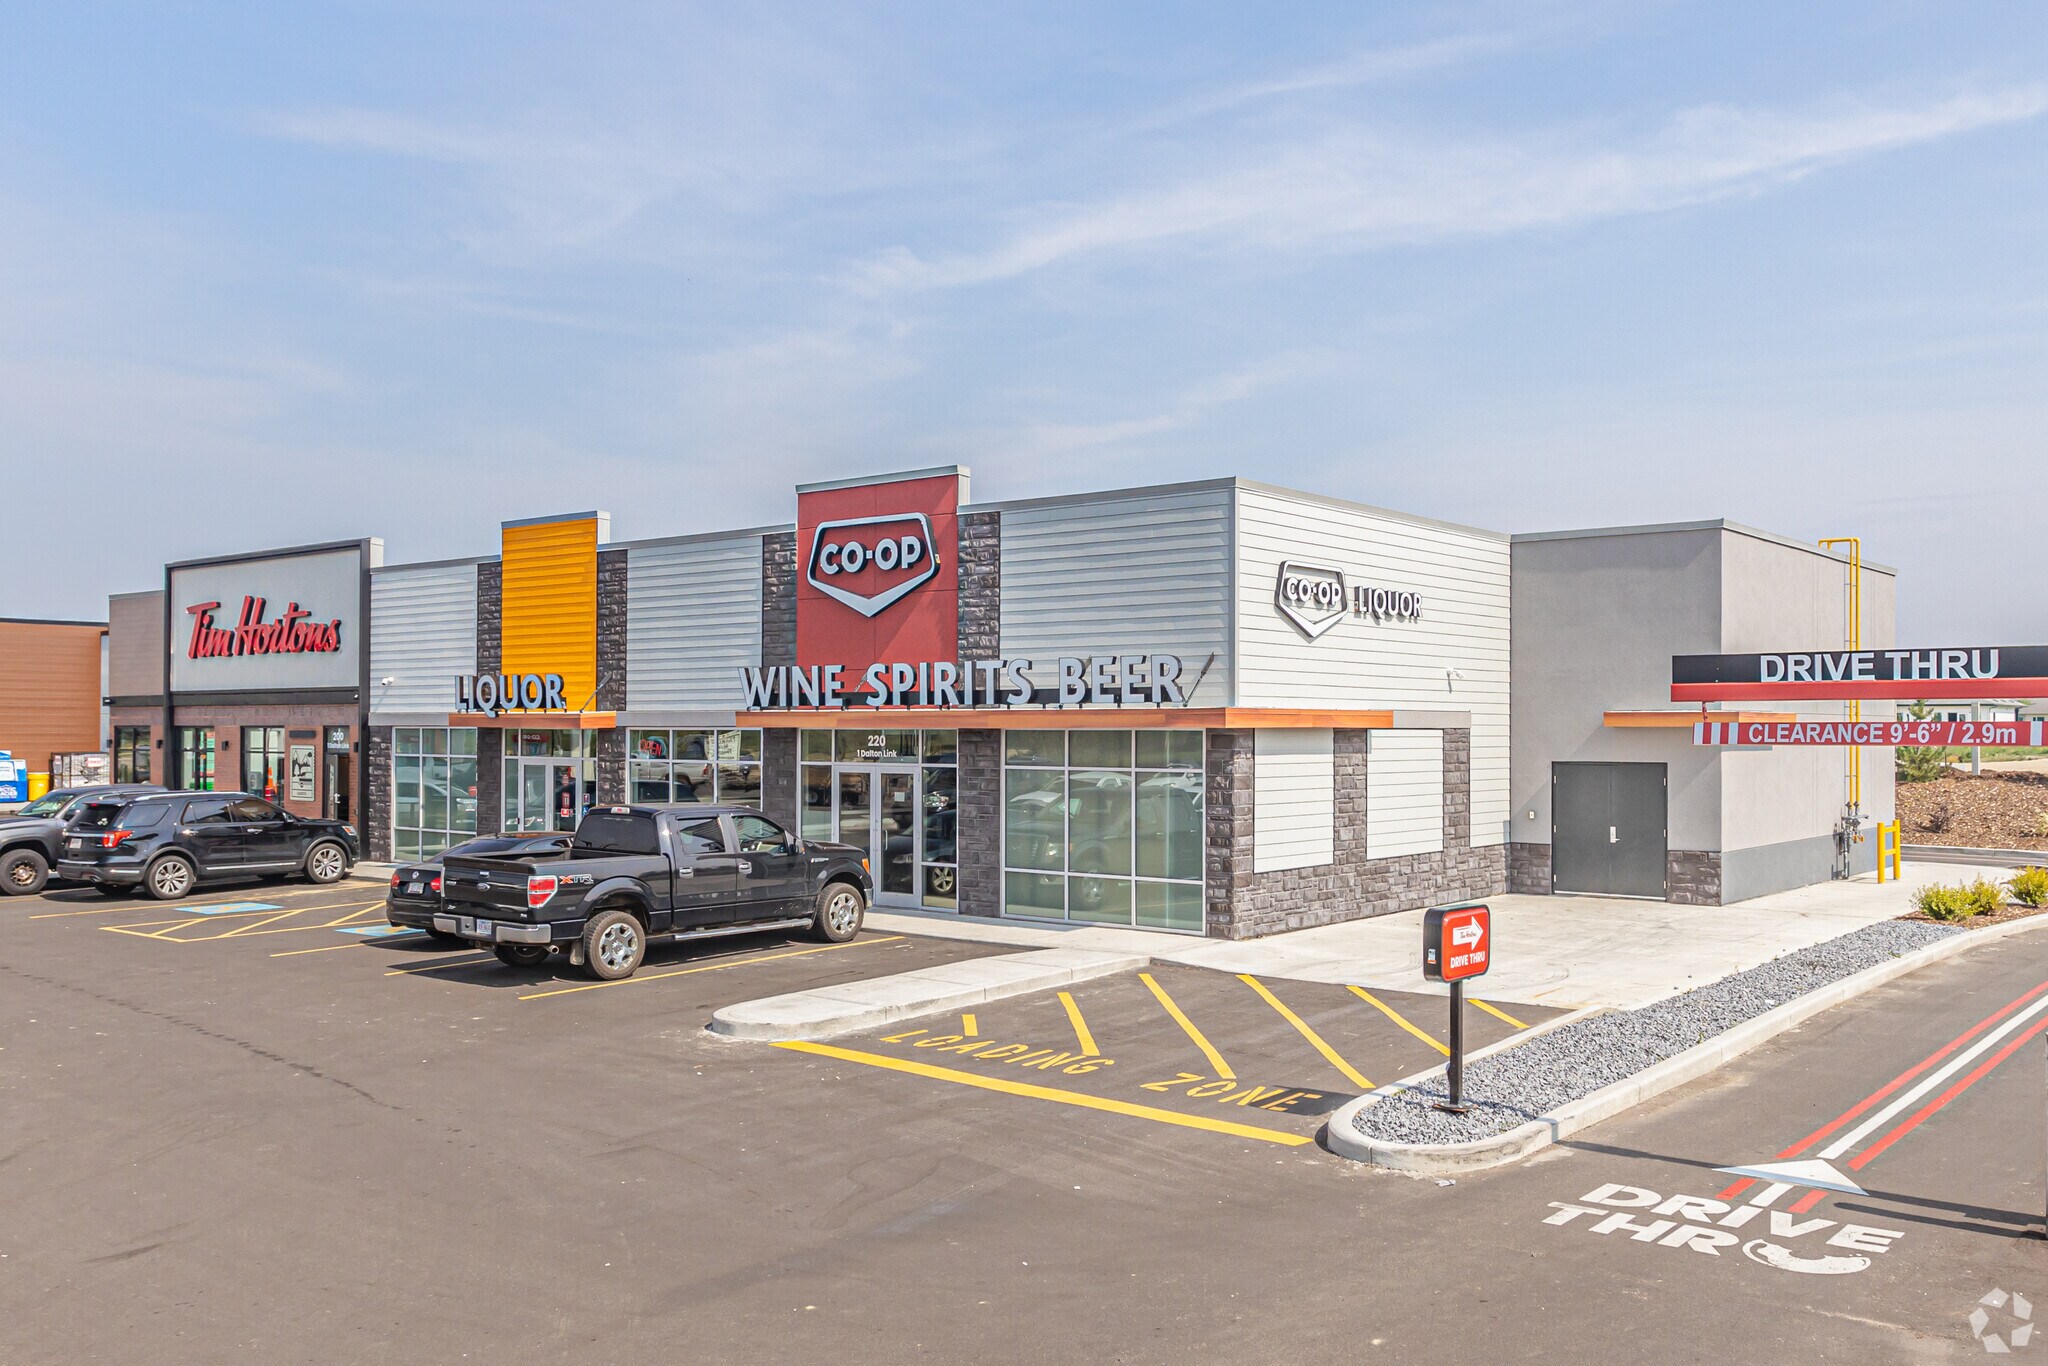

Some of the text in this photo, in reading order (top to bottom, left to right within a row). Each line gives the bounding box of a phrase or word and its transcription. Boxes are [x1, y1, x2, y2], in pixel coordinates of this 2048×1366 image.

[819, 535, 924, 575] CO-OP
[1285, 577, 1423, 619] CO-OP LIQUOR
[186, 595, 342, 660] Tim Hortons
[738, 654, 1185, 708] WINE SPIRITS BEER
[1759, 649, 2000, 682] DRIVE THRU
[454, 673, 565, 718] LIQUOR
[639, 738, 663, 757] OPEN
[860, 749, 883, 758] Dalton
[883, 749, 898, 758] Link
[867, 734, 886, 747] 220
[1747, 723, 1884, 744] CLEARANCE
[1947, 724, 1956, 743] /
[1961, 723, 2017, 744] 2.9m
[1450, 951, 1486, 969] DRIVE THRU
[879, 1028, 1323, 1113] LOADING ZONE
[1578, 1182, 1905, 1254] DRIVE
